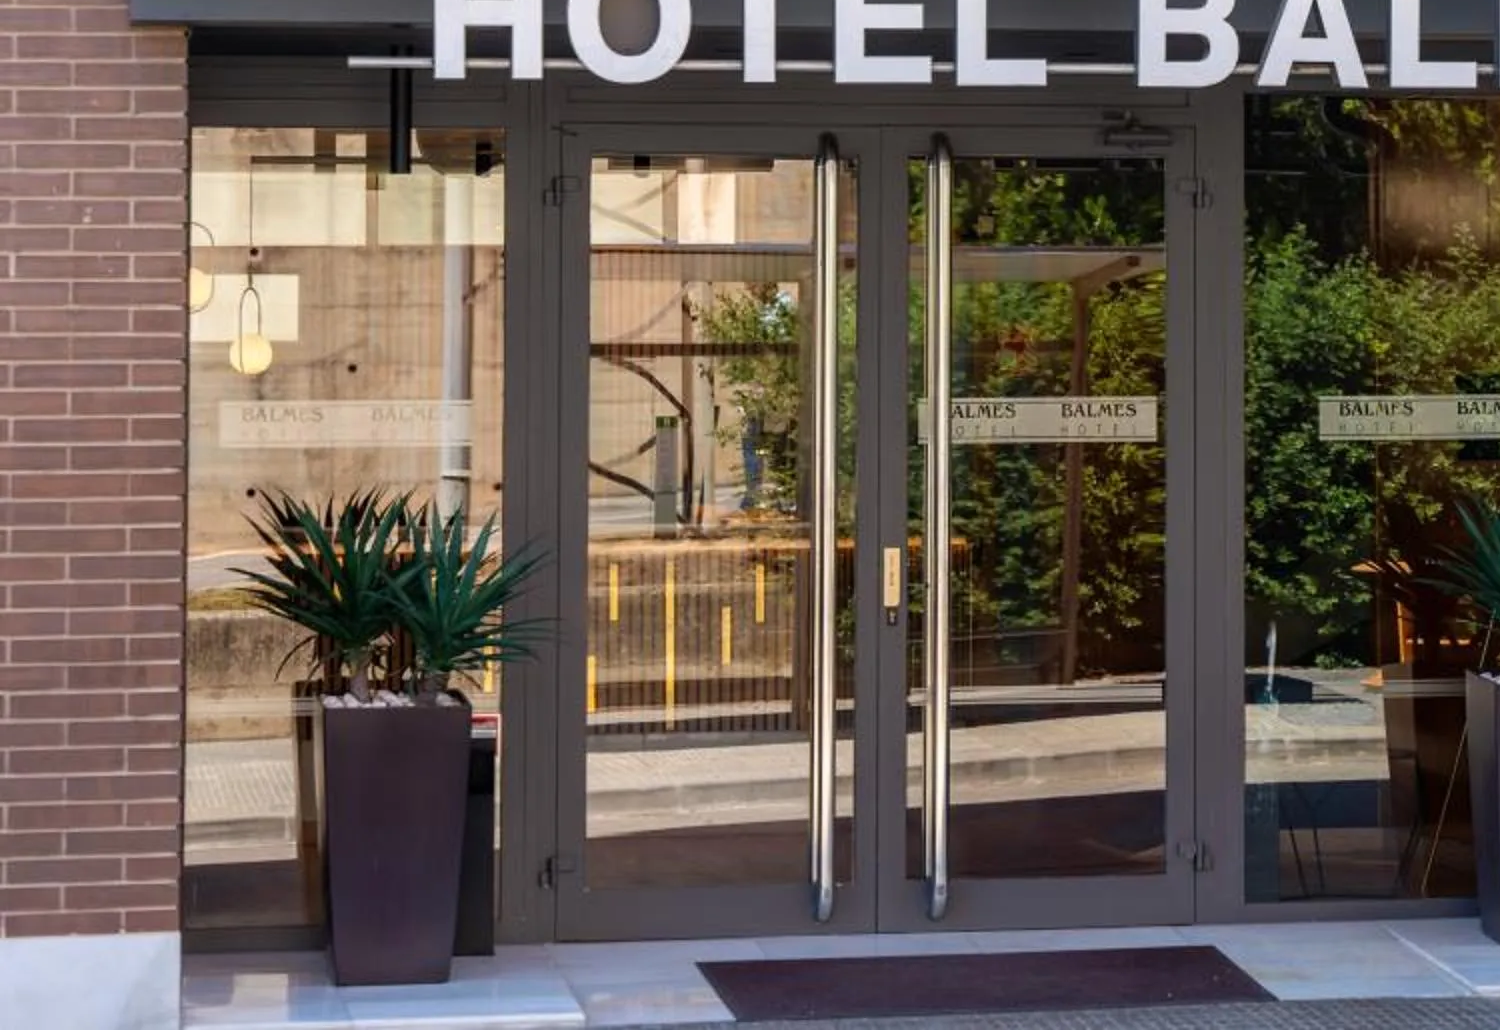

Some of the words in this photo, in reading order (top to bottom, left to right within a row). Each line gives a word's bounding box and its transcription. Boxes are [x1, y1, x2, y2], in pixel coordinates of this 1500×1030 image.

[241, 406, 324, 423] BALMES
[948, 403, 1017, 419] ALMES
[1061, 403, 1137, 419] BALMES
[1340, 401, 1414, 417] BALMES
[955, 425, 1016, 438] OTEL
